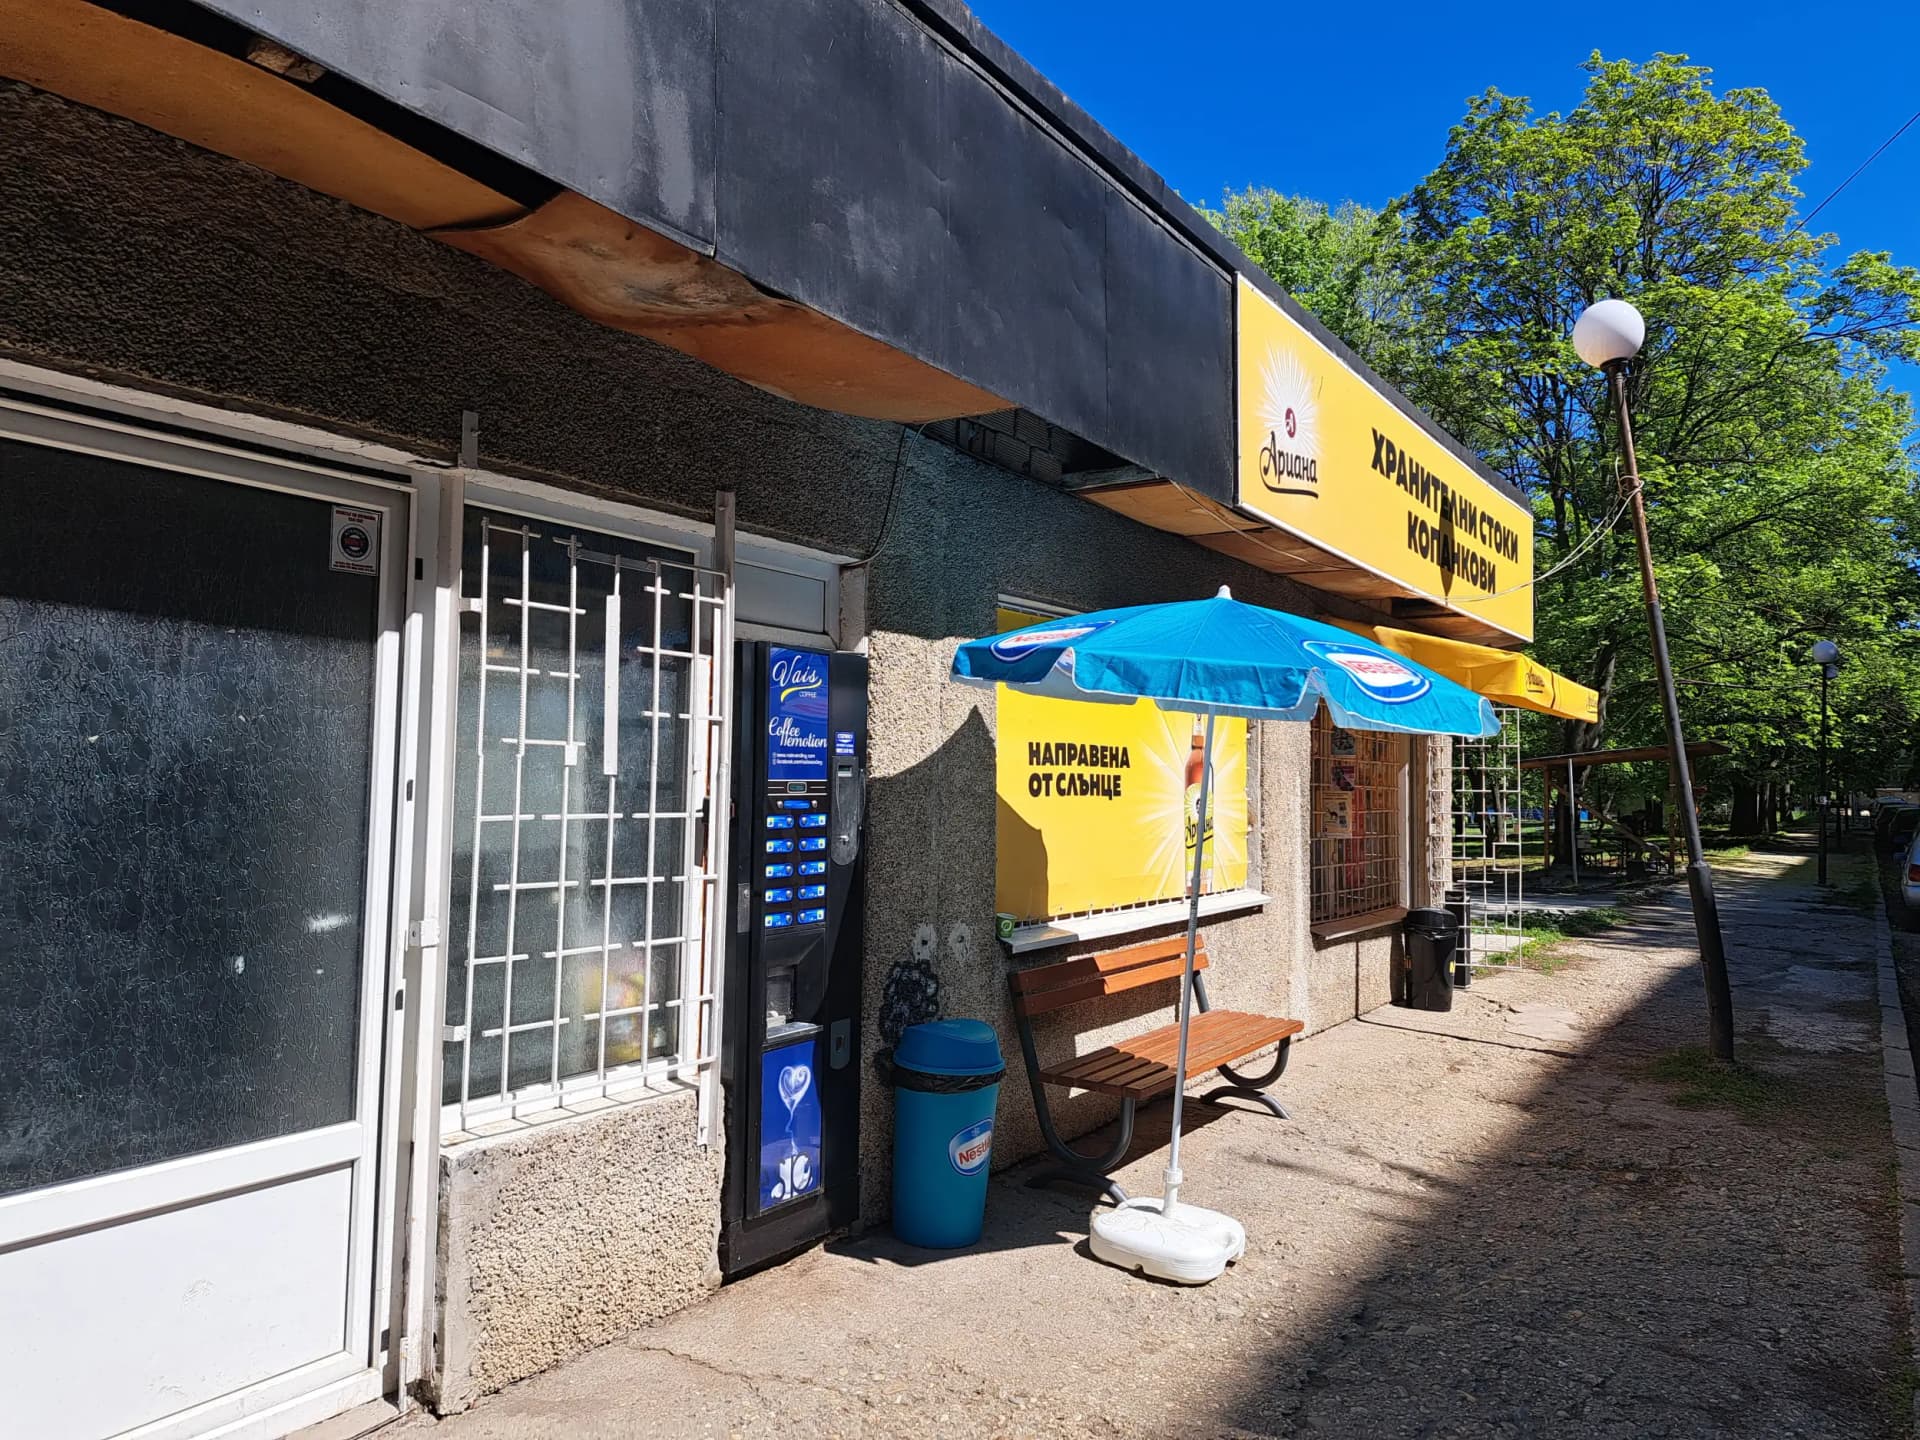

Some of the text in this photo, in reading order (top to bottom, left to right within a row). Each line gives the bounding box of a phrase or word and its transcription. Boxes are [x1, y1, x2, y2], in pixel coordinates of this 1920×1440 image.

[1259, 430, 1318, 497] Ариана
[1371, 427, 1519, 564] ХРАНИТЕЛНИ СТОКИ
[1407, 510, 1496, 594] КОПАНКОВИ
[772, 655, 819, 687] Vais
[769, 716, 800, 746] Coffee
[786, 732, 828, 748] emotion
[1028, 742, 1130, 768] НАПРАВЕНА
[1028, 773, 1122, 800] ОТ СЛЪНЦЕ
